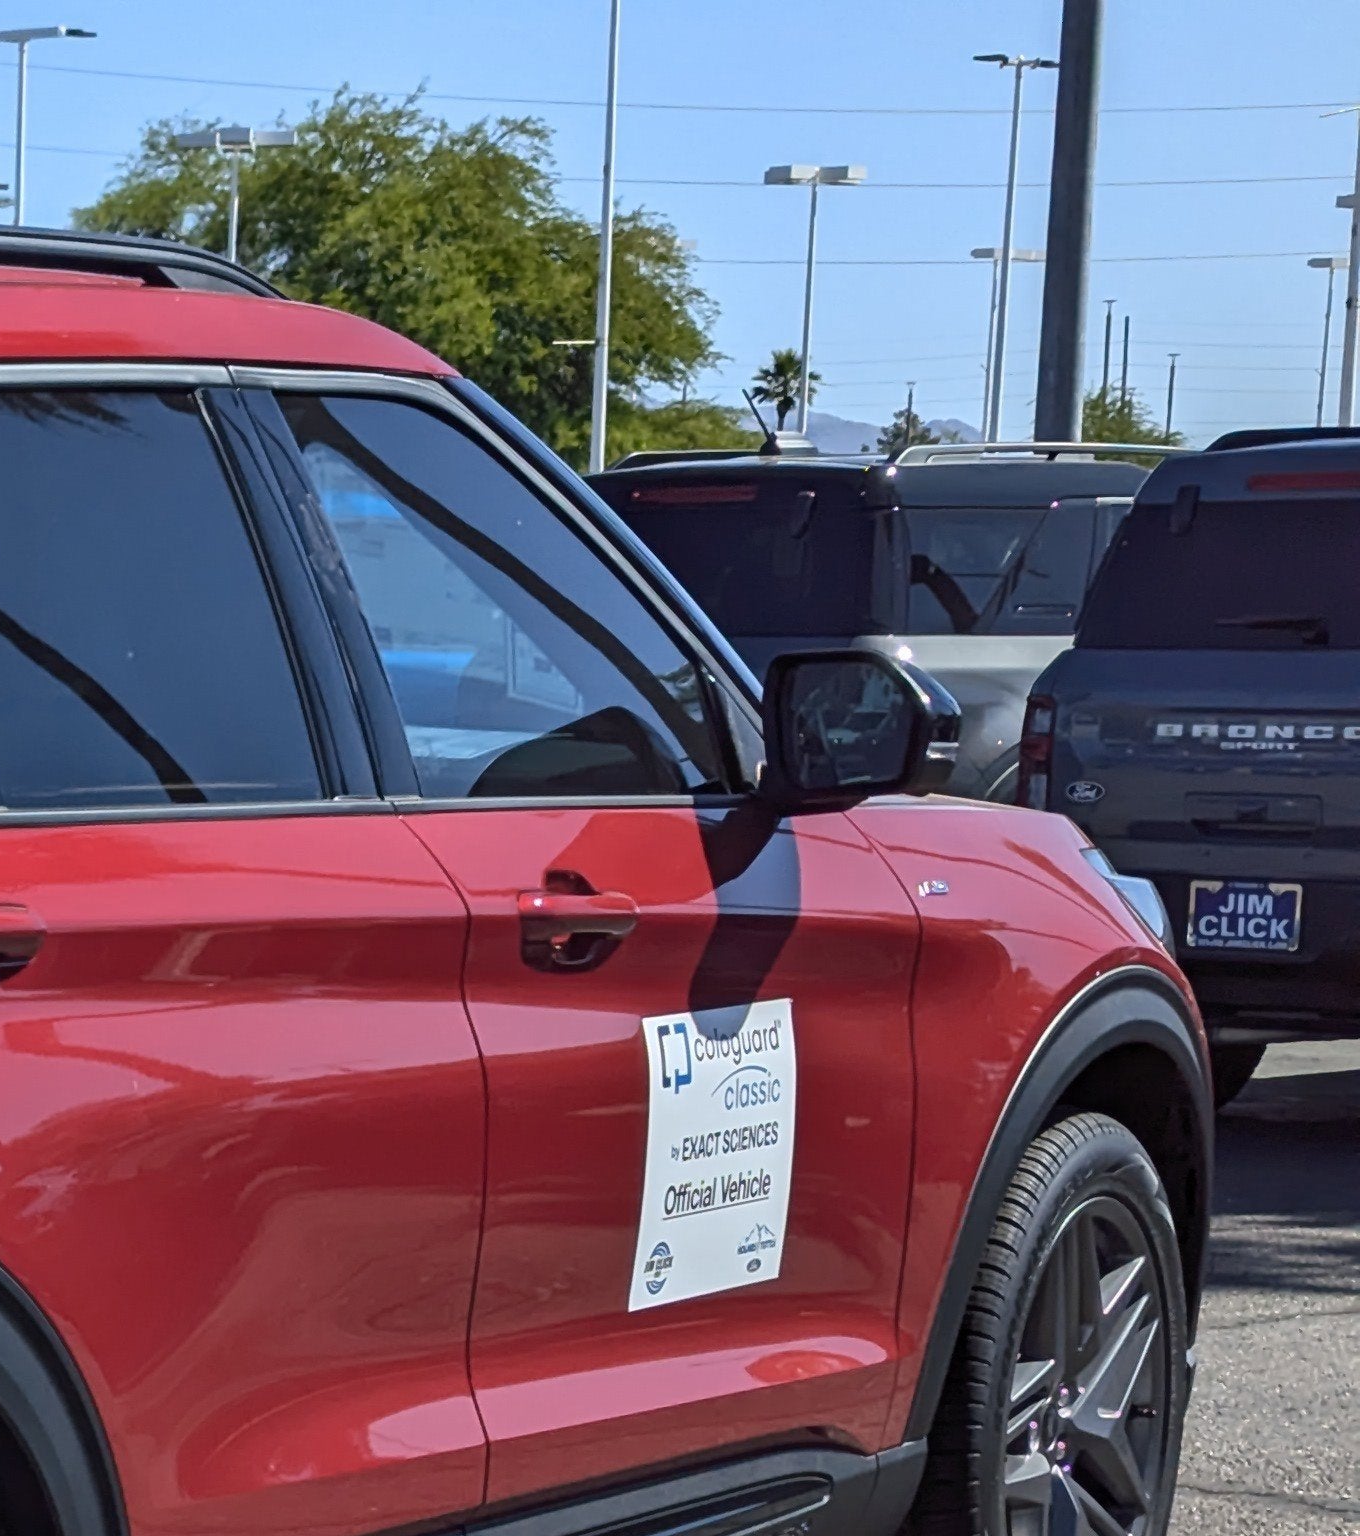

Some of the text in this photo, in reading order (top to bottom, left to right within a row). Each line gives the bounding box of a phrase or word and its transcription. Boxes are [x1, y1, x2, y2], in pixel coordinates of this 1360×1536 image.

[1218, 893, 1273, 916] JIM
[1198, 915, 1289, 940] CLICK
[724, 1071, 781, 1110] classic
[670, 1120, 779, 1161] by EXACT SCIENCES
[664, 1168, 771, 1215] Official Vehicle
